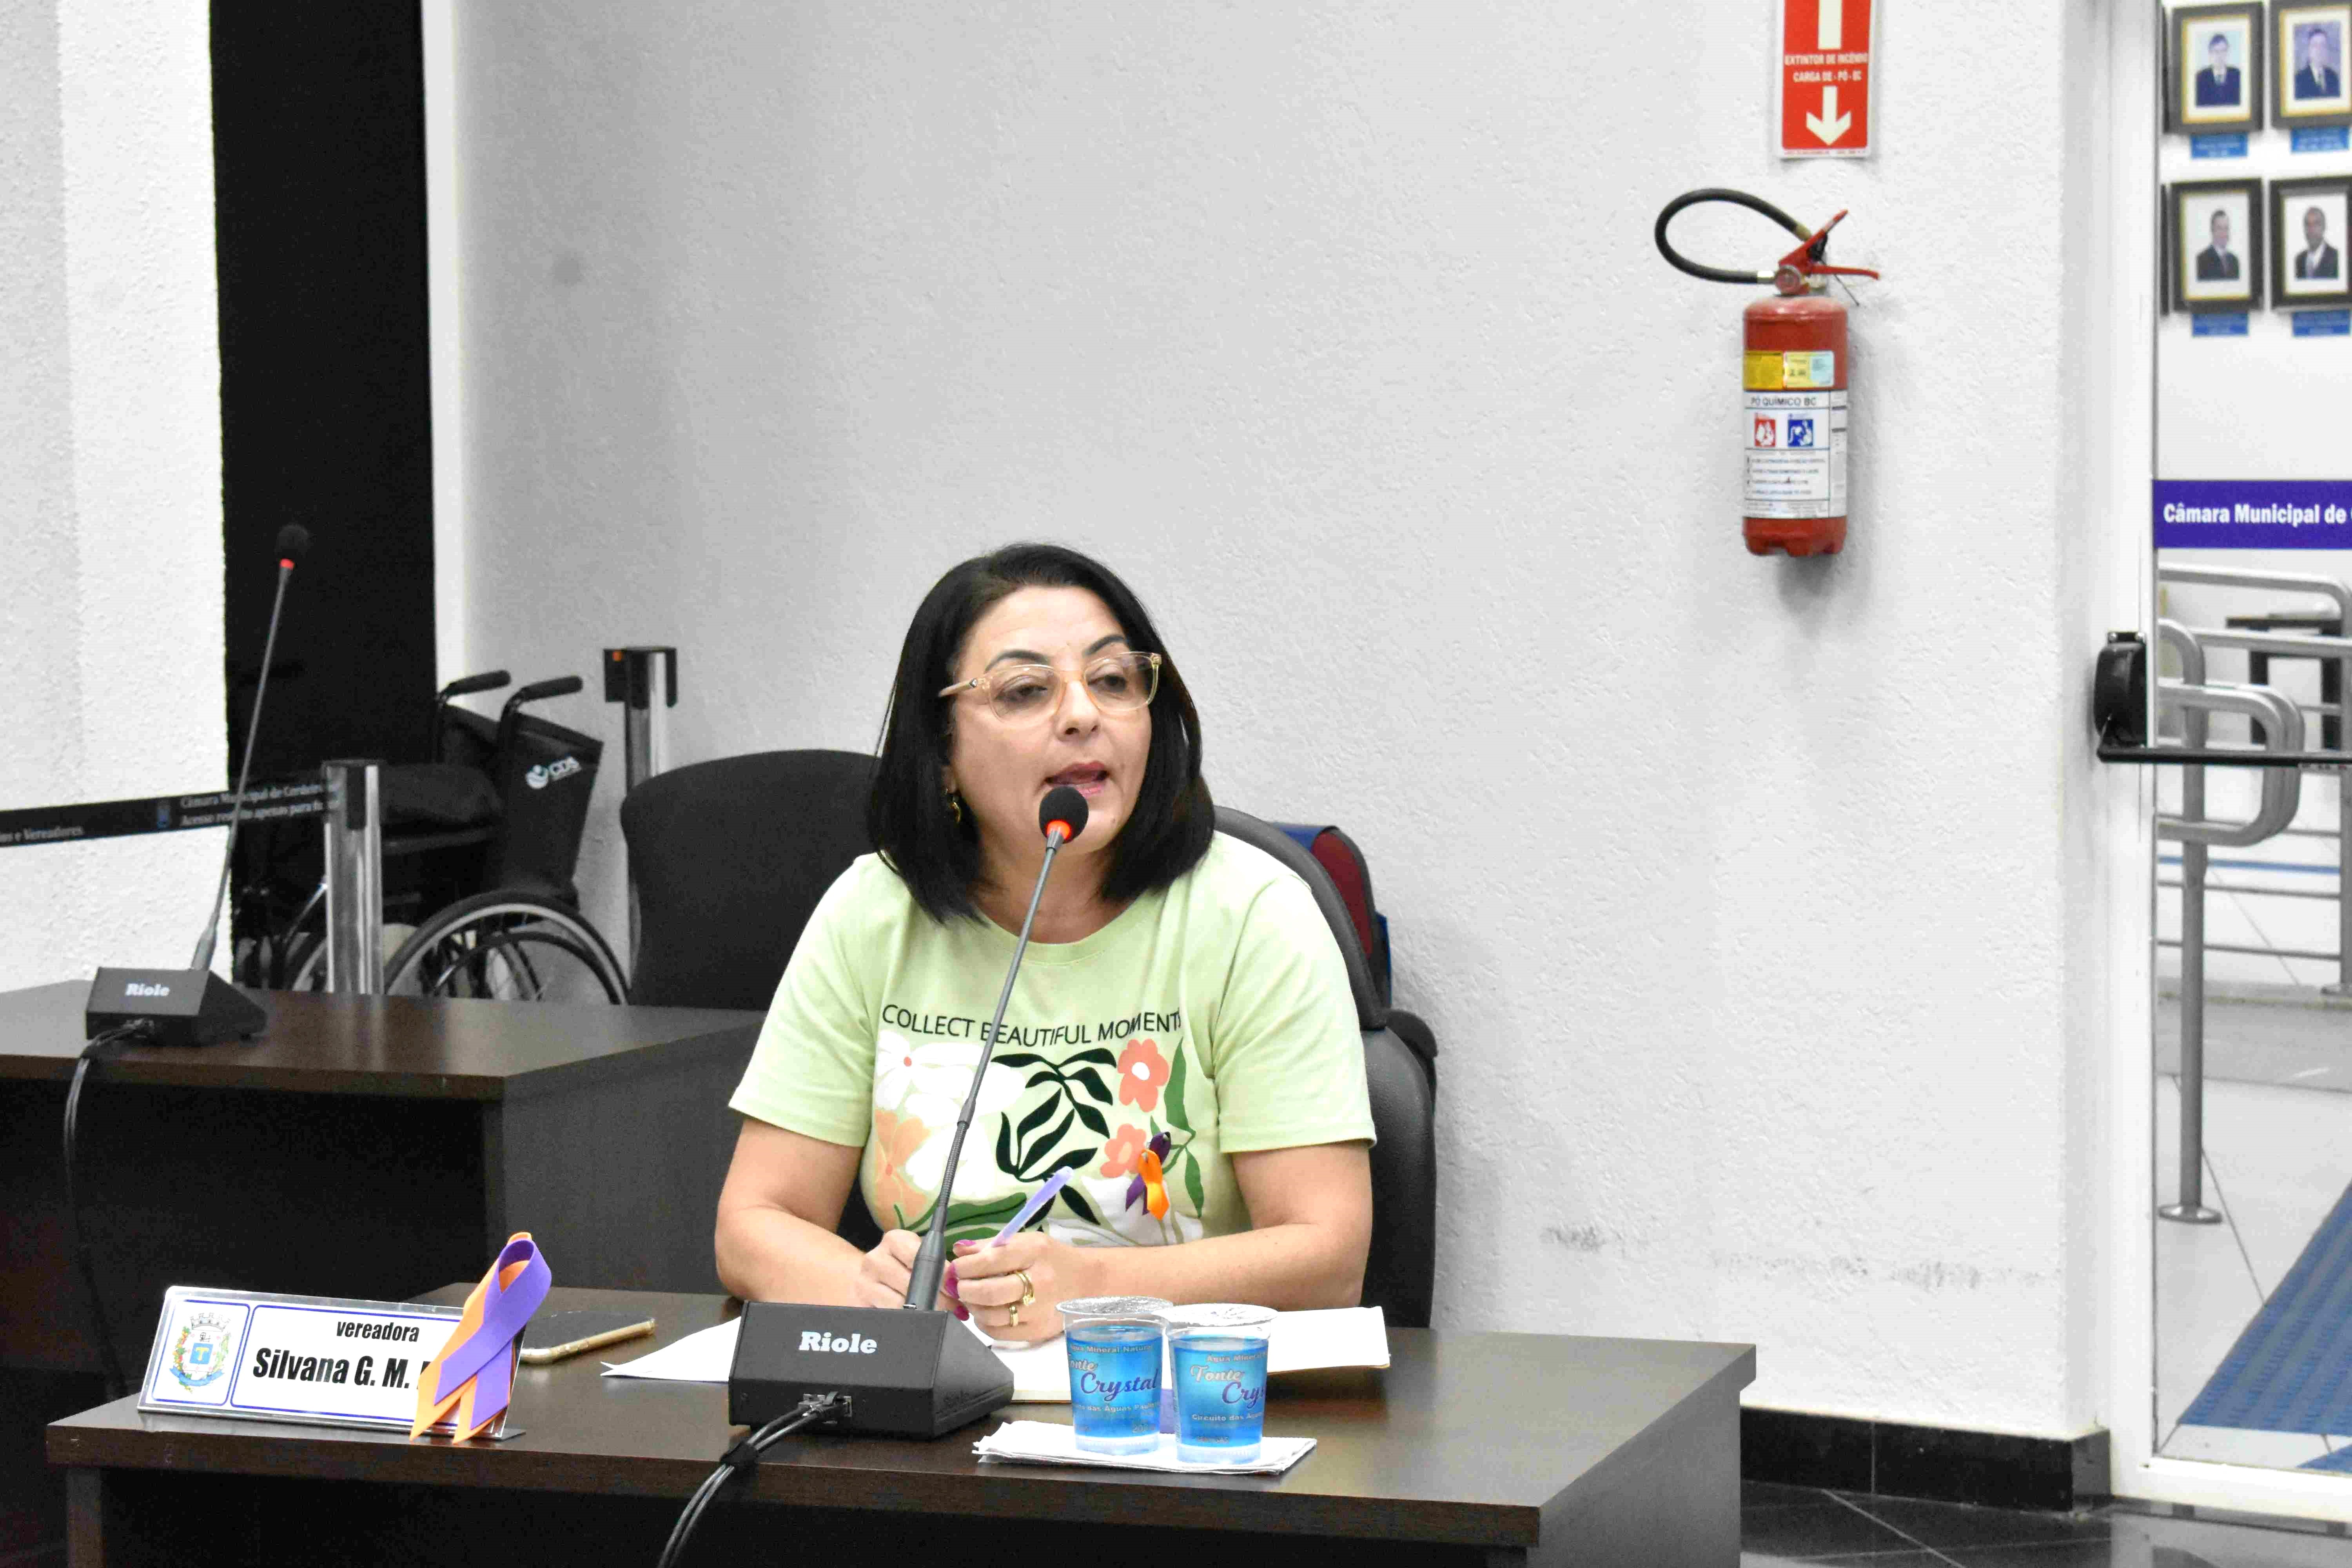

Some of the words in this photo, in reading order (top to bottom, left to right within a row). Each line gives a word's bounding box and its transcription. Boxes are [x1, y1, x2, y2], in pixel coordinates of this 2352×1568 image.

[1826, 54, 1836, 64] DE
[1804, 396, 1817, 406] BC
[2163, 502, 2230, 523] Câmara
[2234, 503, 2320, 528] Municipal
[2324, 504, 2347, 524] de
[124, 983, 171, 997] Riole
[882, 1004, 976, 1038] COLLECT
[980, 1022, 1092, 1047] BEAUTIFUL
[336, 1321, 420, 1342] vereadora
[799, 1331, 878, 1354] Riole
[1087, 1345, 1120, 1354] Mineral
[252, 1347, 350, 1384] Silvana
[354, 1355, 376, 1387] G.
[381, 1357, 410, 1389] M.
[1068, 1358, 1098, 1371] onte
[1080, 1368, 1159, 1402] Crystal
